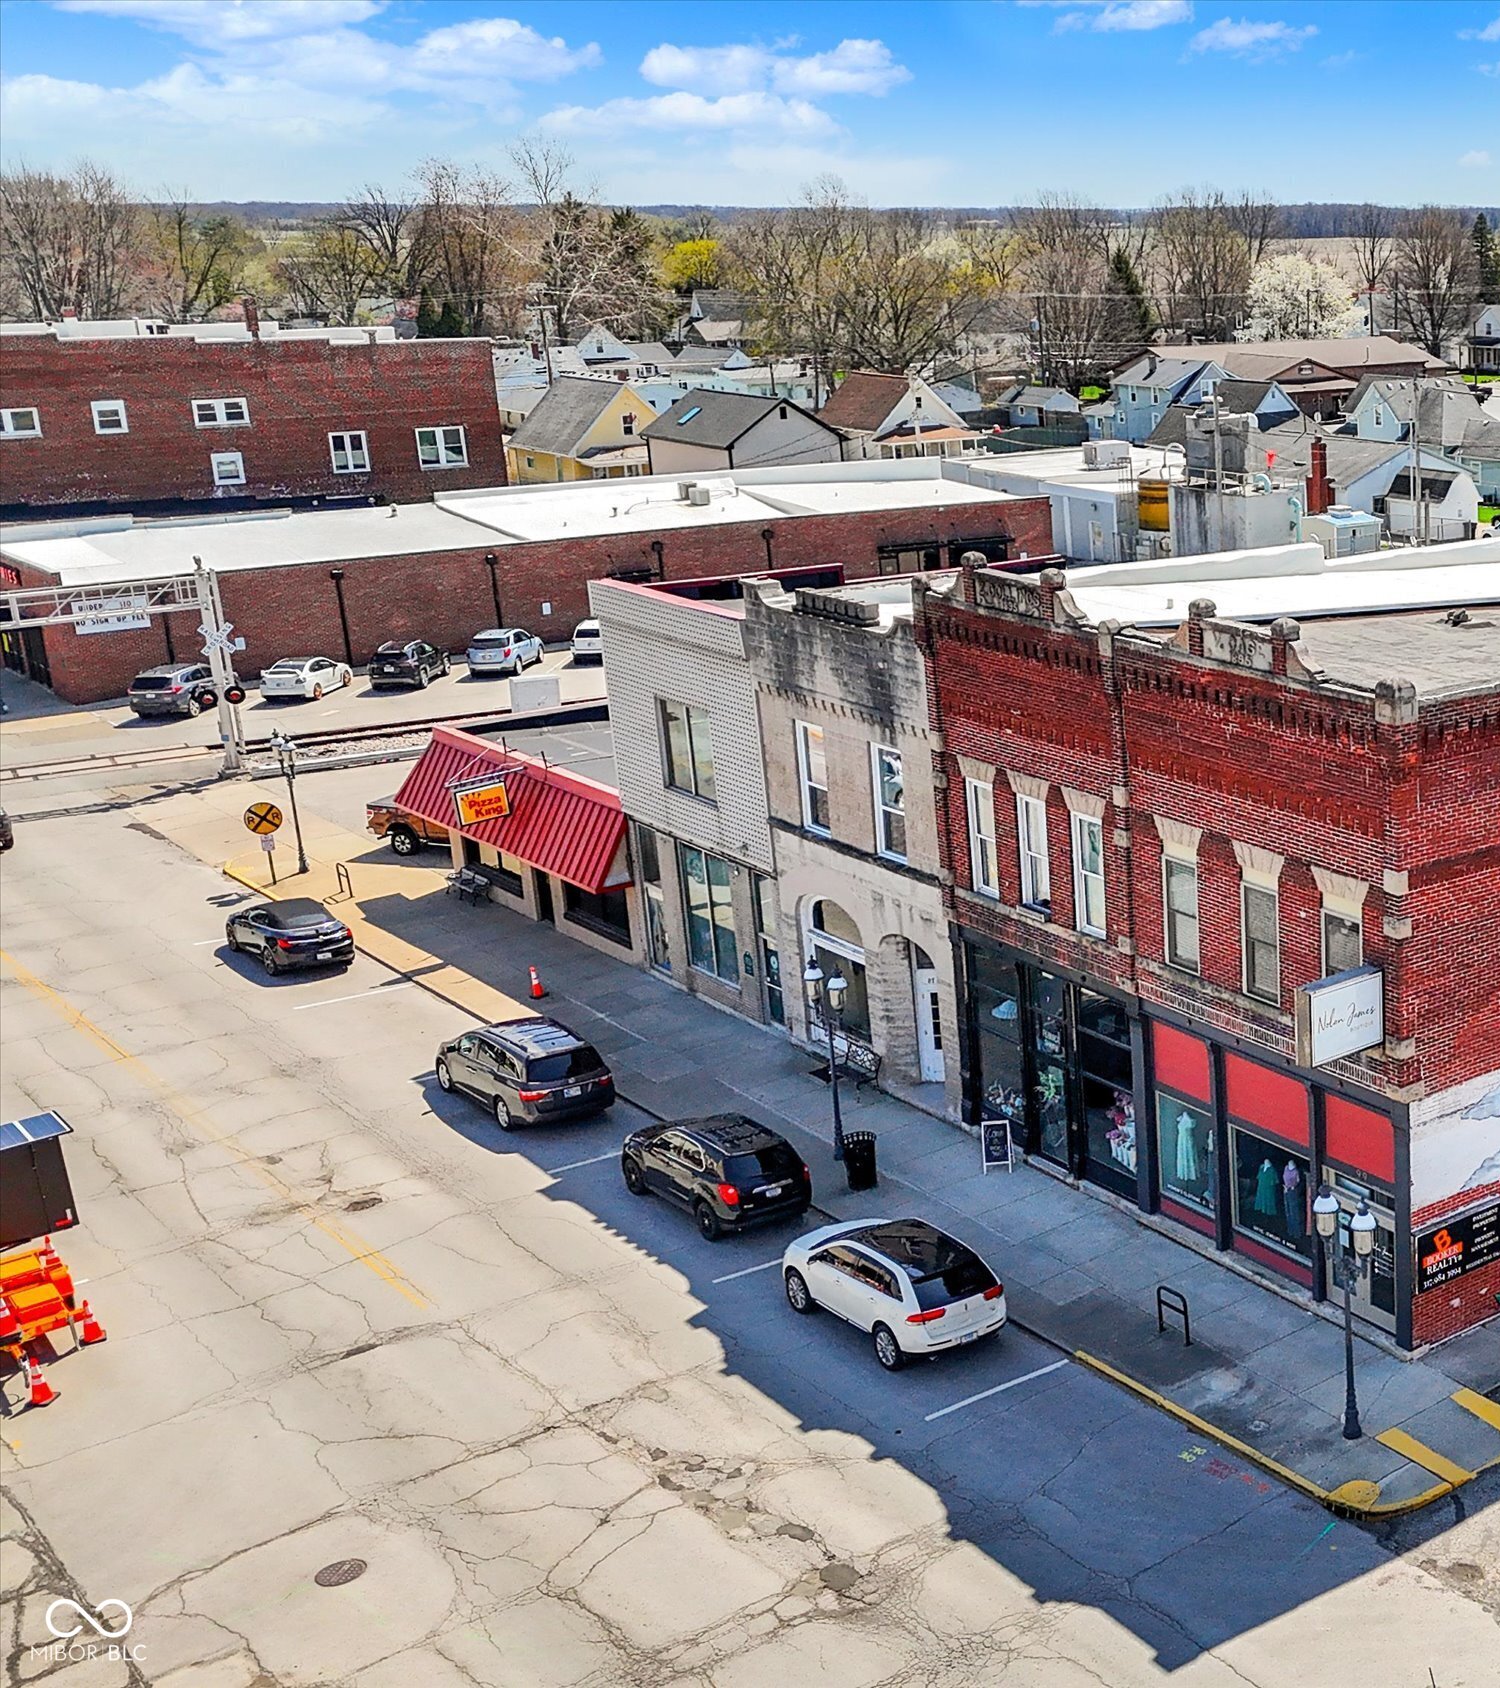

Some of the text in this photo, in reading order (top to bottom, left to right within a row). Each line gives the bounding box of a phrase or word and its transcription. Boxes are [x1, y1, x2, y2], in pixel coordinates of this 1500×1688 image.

[468, 796, 502, 810] Pizza
[474, 805, 504, 818] King
[247, 811, 280, 825] R R
[1346, 1001, 1376, 1028] James
[1433, 1229, 1452, 1253] B
[1426, 1244, 1459, 1267] BOOKER
[1427, 1254, 1458, 1275] REALTY
